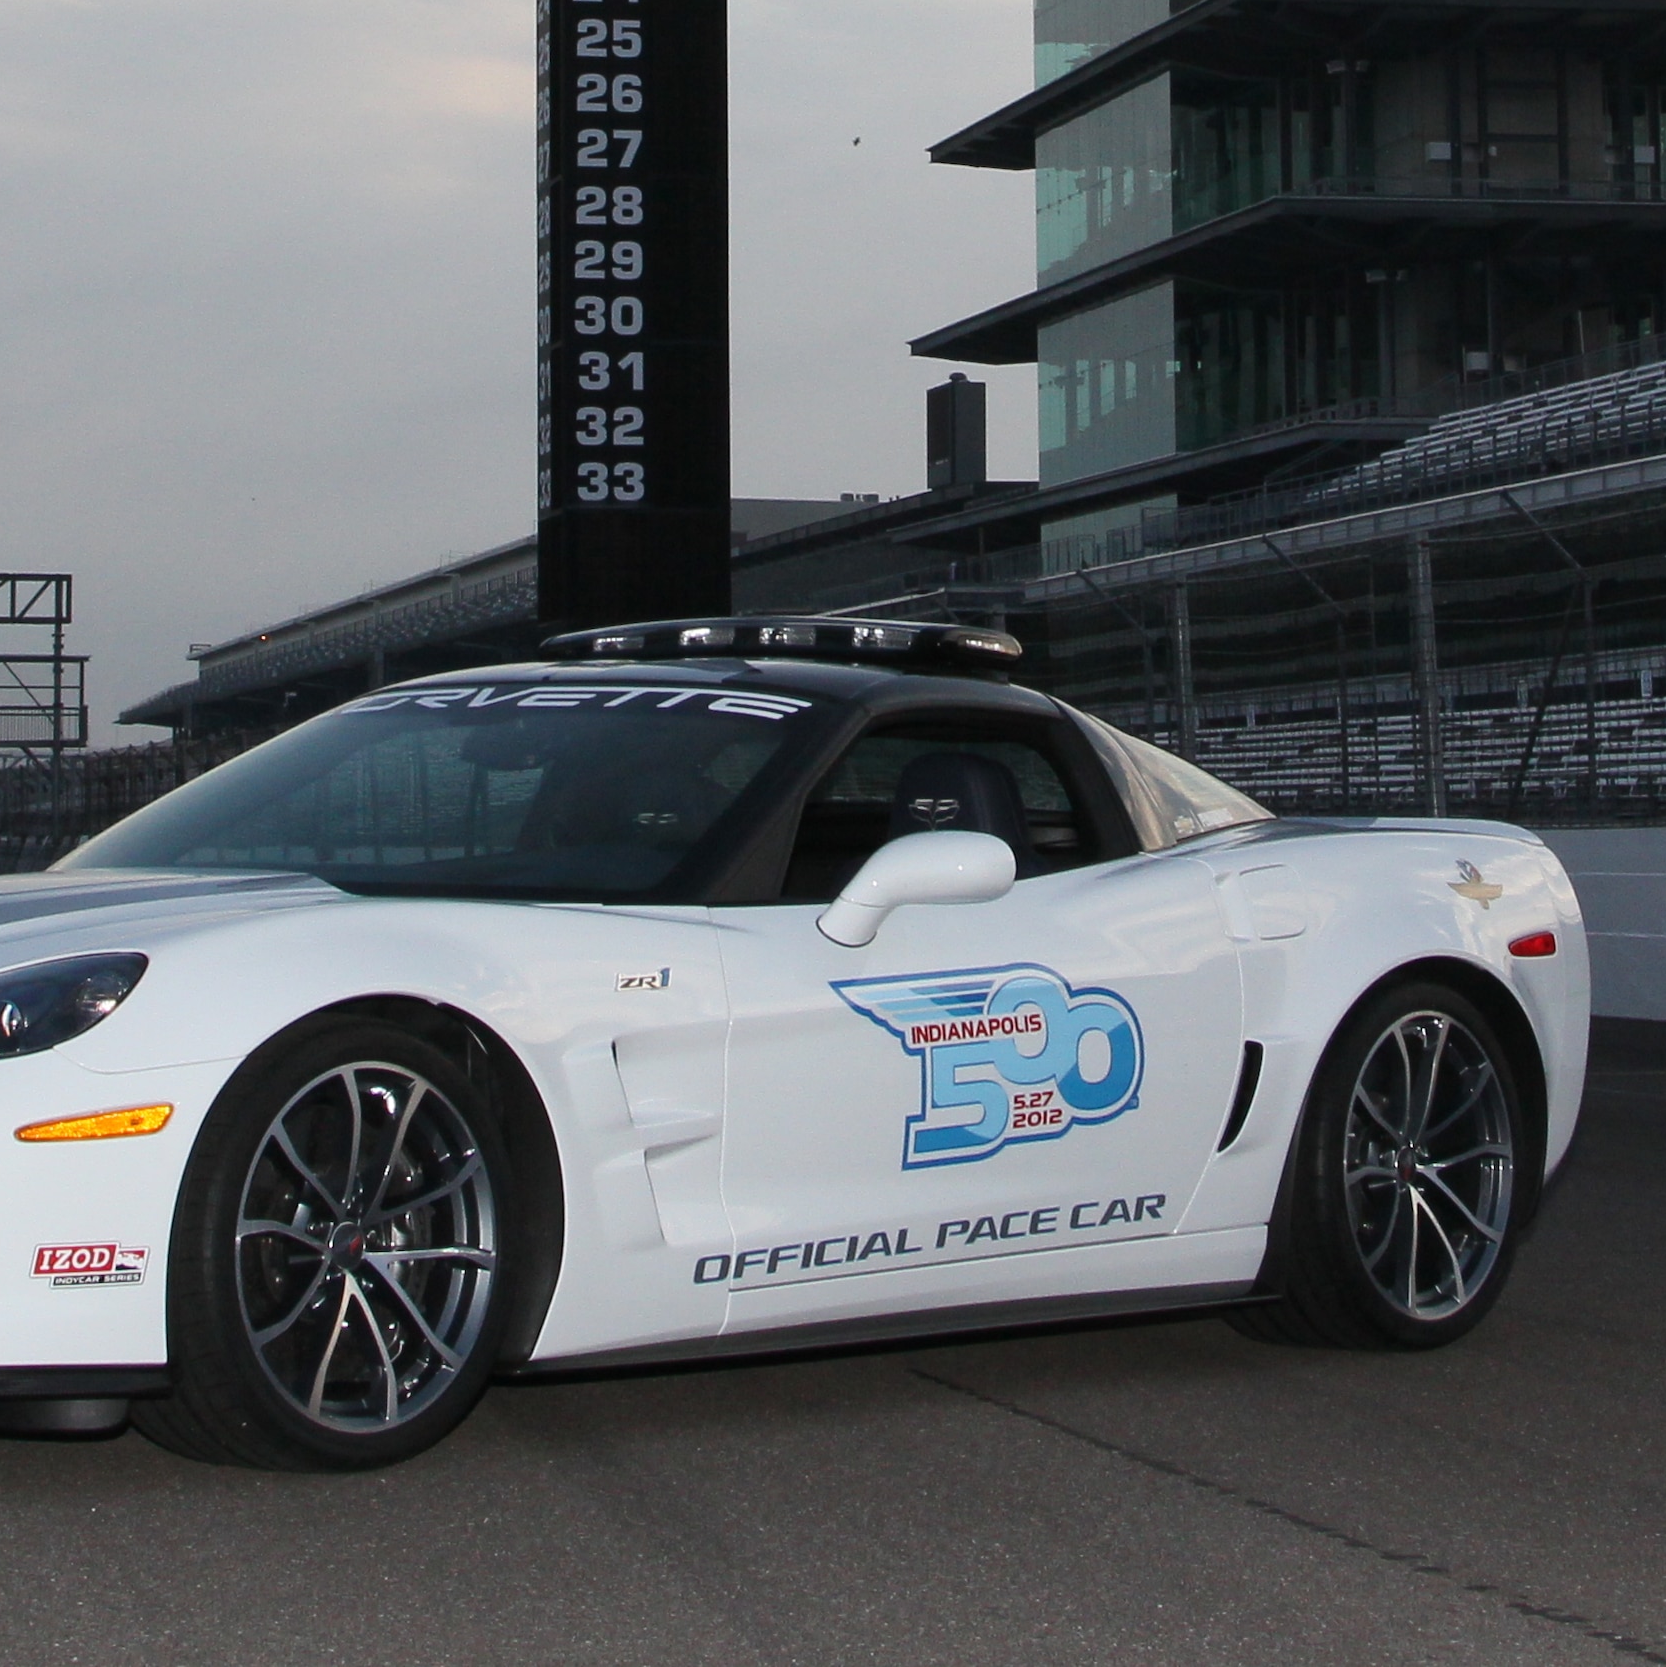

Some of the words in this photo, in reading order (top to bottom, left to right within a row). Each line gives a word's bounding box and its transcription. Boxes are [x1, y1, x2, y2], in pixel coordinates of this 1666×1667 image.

[576, 19, 642, 58] 25
[576, 74, 643, 112] 26
[577, 129, 643, 167] 27
[576, 186, 643, 225] 28
[574, 240, 643, 280] 29
[574, 296, 643, 335] 30
[579, 352, 644, 390] 31
[576, 407, 644, 445] 32
[577, 462, 645, 501] 33
[340, 685, 813, 720] ORVETTE
[620, 967, 671, 989] ZR1
[911, 1014, 1042, 1044] INDIANAPOLIS
[913, 976, 1137, 1154] 500
[1012, 1109, 1063, 1129] 2012
[1013, 1091, 1054, 1110] 5.27
[693, 1228, 923, 1285] OFFICIAL
[935, 1206, 1061, 1249] PACE
[1069, 1194, 1166, 1230] CAR
[39, 1248, 110, 1271] IZOD
[55, 1275, 100, 1285] INDYCAR
[103, 1273, 140, 1283] SERIES
